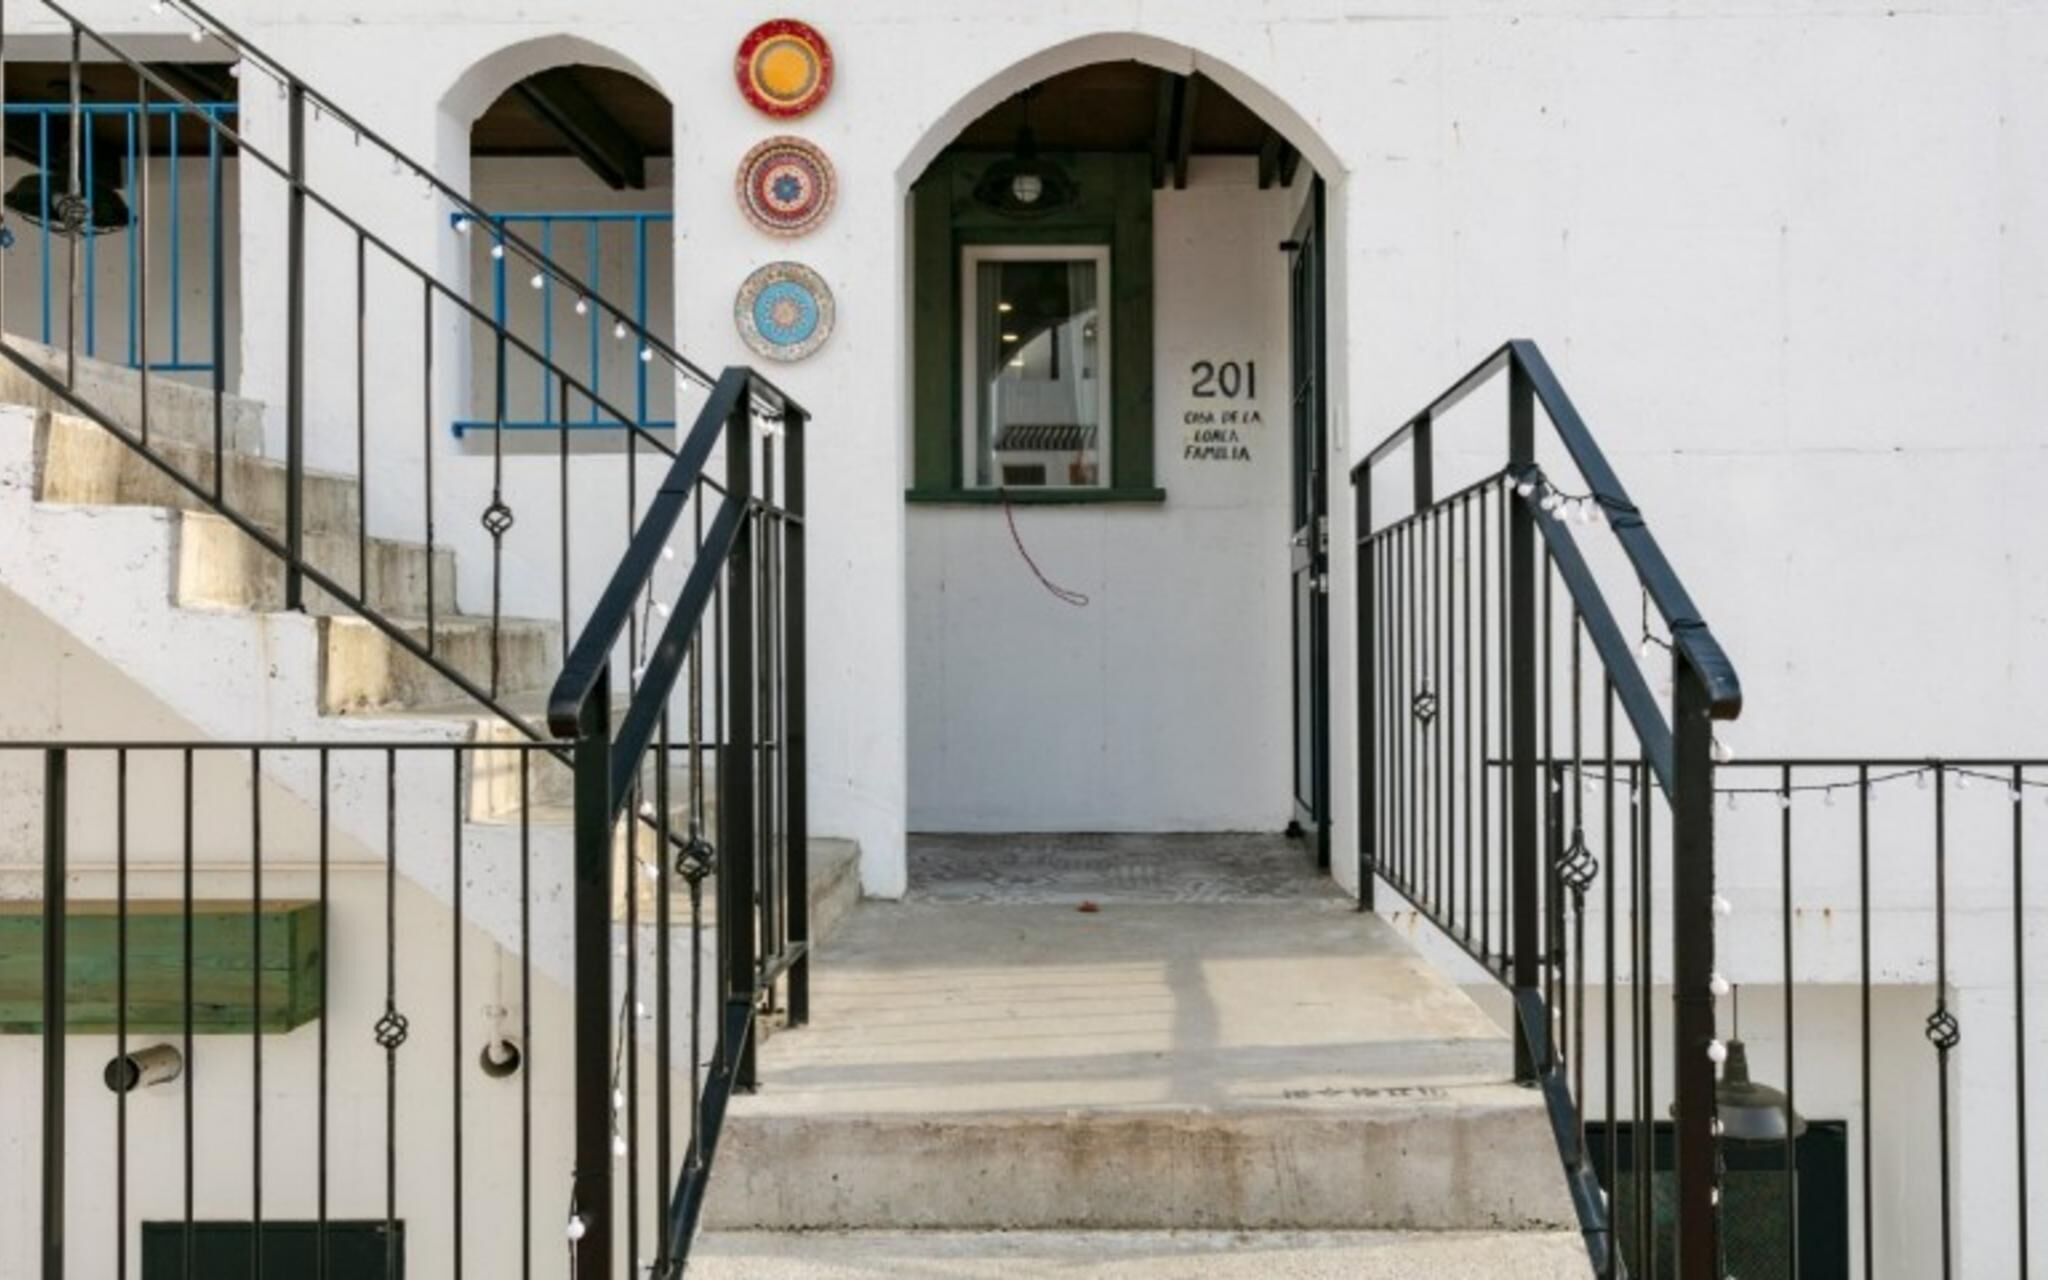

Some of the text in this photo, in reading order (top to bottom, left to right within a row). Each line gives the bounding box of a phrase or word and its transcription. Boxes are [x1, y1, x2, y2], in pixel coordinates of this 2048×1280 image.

[1191, 359, 1255, 399] 201
[1221, 410, 1239, 424] DE
[1242, 410, 1262, 424] LA
[1184, 445, 1251, 462] FAMILIA
